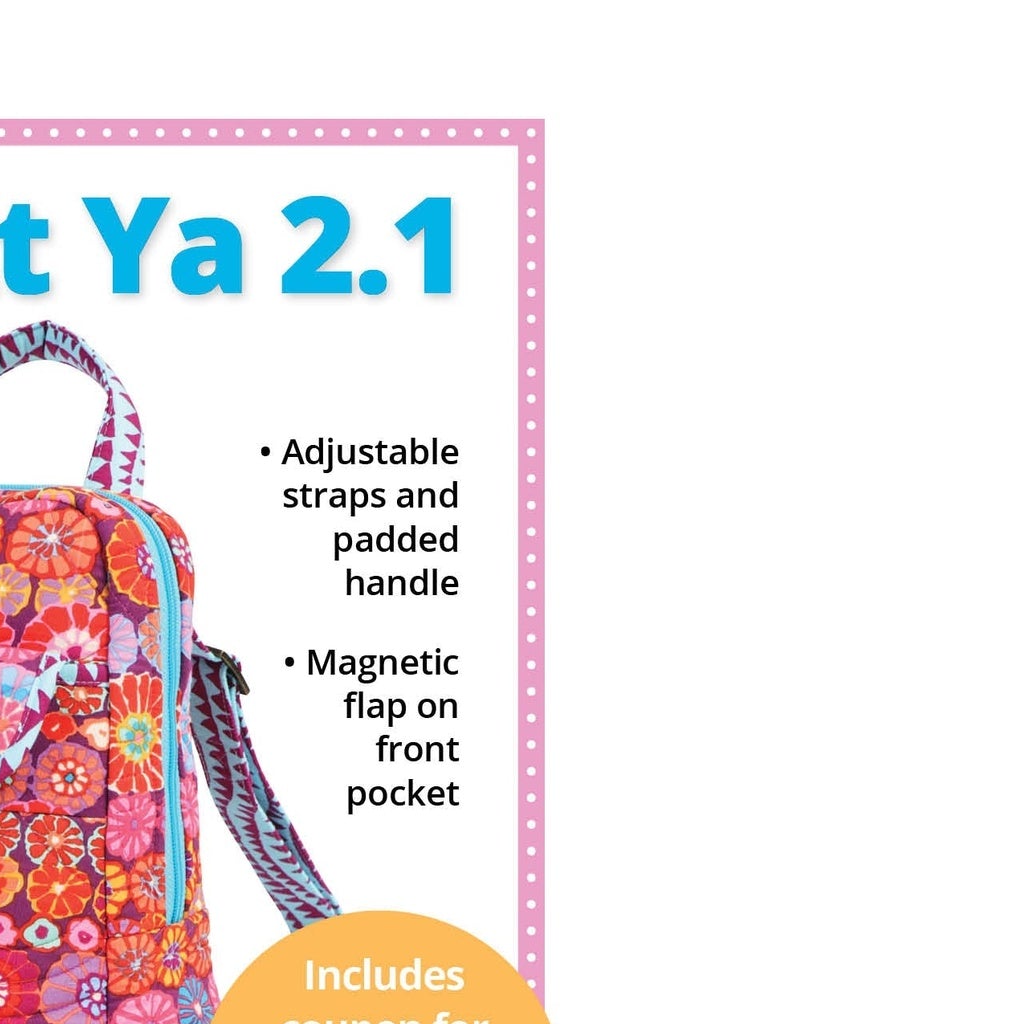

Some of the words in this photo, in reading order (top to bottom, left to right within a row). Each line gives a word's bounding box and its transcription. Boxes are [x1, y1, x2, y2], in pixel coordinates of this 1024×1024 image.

[81, 196, 243, 296] Ya
[281, 195, 452, 296] 2.1
[280, 437, 459, 472] Adjustable
[283, 483, 386, 516] straps
[396, 480, 458, 509] and
[334, 524, 458, 560] padded
[346, 568, 459, 596] handle
[308, 647, 459, 684] Magnetic
[343, 690, 407, 728] flap
[417, 698, 458, 719] on
[375, 734, 460, 762] front
[347, 778, 460, 815] pocket
[306, 957, 465, 991] Includes
